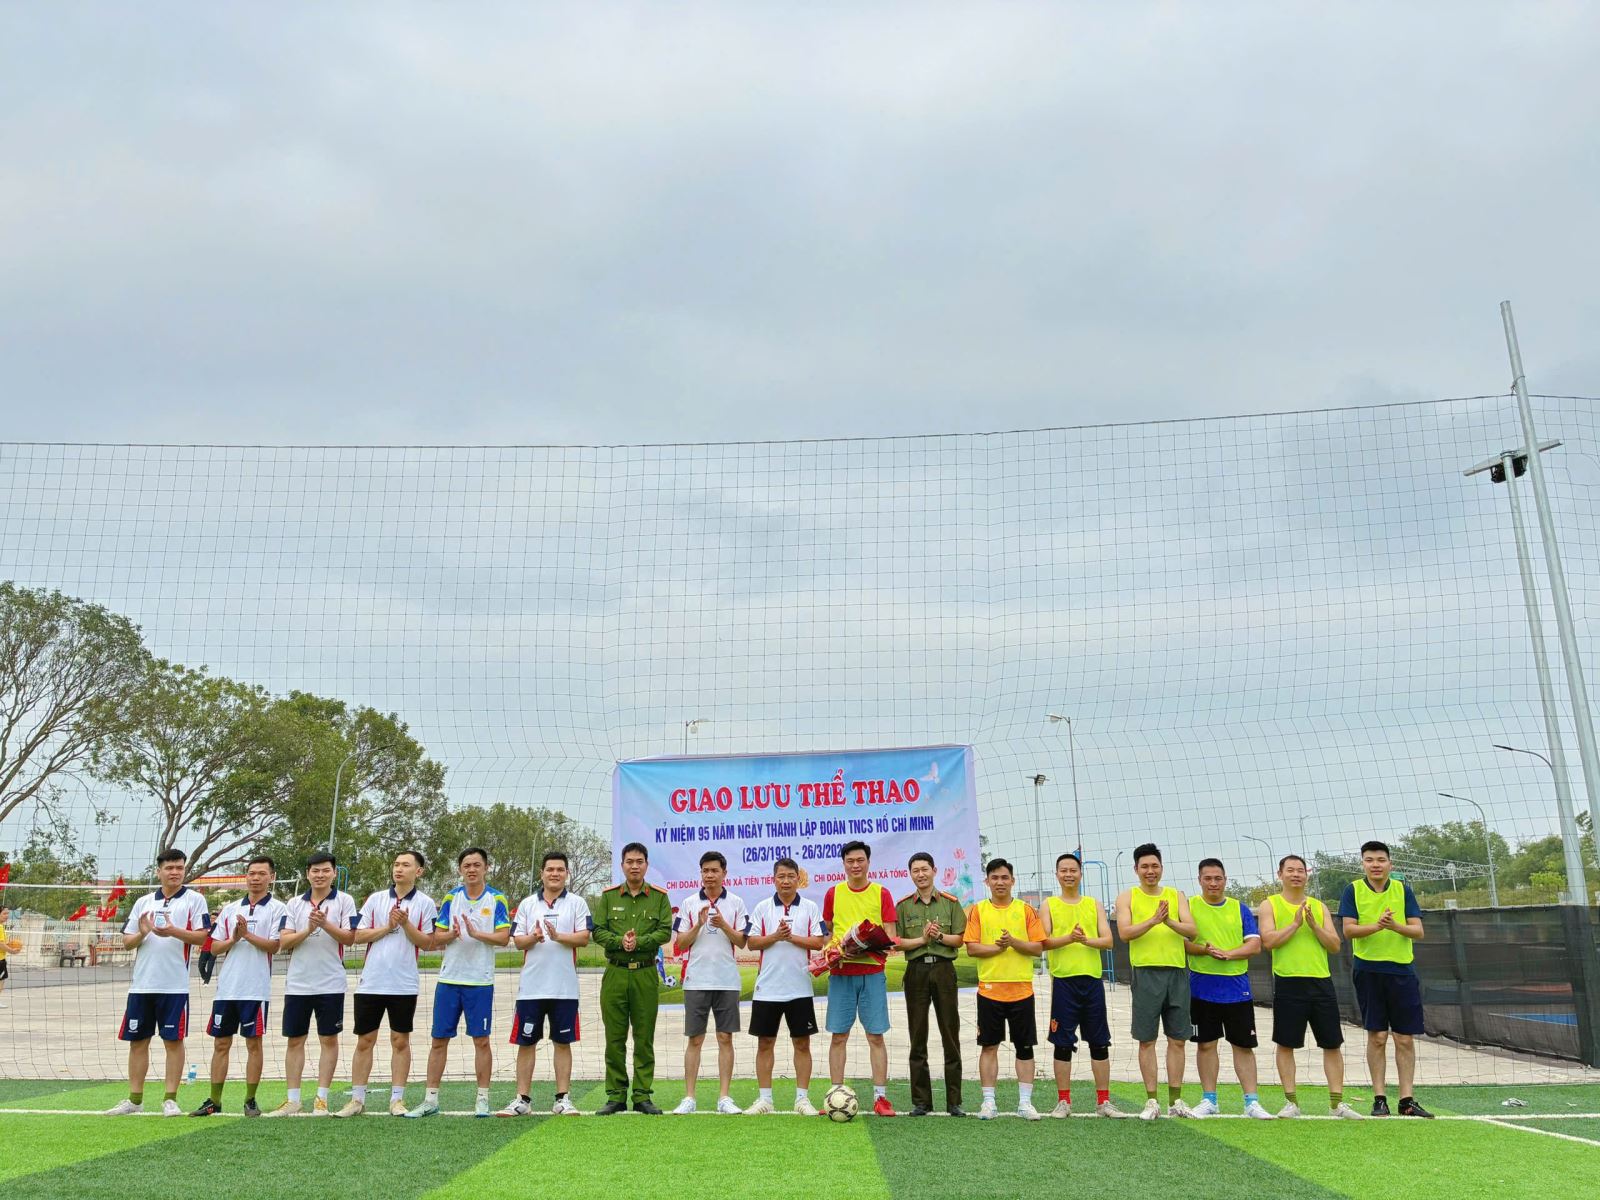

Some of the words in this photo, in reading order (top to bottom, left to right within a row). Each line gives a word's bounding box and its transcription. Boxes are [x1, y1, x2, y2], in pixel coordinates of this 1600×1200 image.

[671, 786, 733, 813] GIAO
[739, 782, 791, 810] LƯU
[797, 768, 847, 807] THỂ
[852, 778, 920, 805] THAO
[655, 822, 668, 843] KỶ
[670, 824, 696, 845] NIỆM
[698, 826, 710, 841] 95
[712, 822, 735, 841] NĂM
[738, 821, 763, 839] NGÀY
[766, 819, 797, 838] THÀNH
[799, 818, 817, 839] LẬP
[820, 818, 846, 836] ĐOÀN
[848, 818, 873, 834] TNCS
[891, 814, 907, 832] CHÍ
[909, 815, 934, 831] MINH
[742, 845, 791, 864] (26/3/1931
[814, 873, 826, 883] CHI
[826, 872, 846, 882] ĐOÀN
[878, 868, 889, 879] XÃ
[890, 866, 908, 879] TỐNG
[666, 880, 678, 890] CHI
[679, 878, 699, 889] ĐOÀN
[483, 1018, 488, 1031] 1
